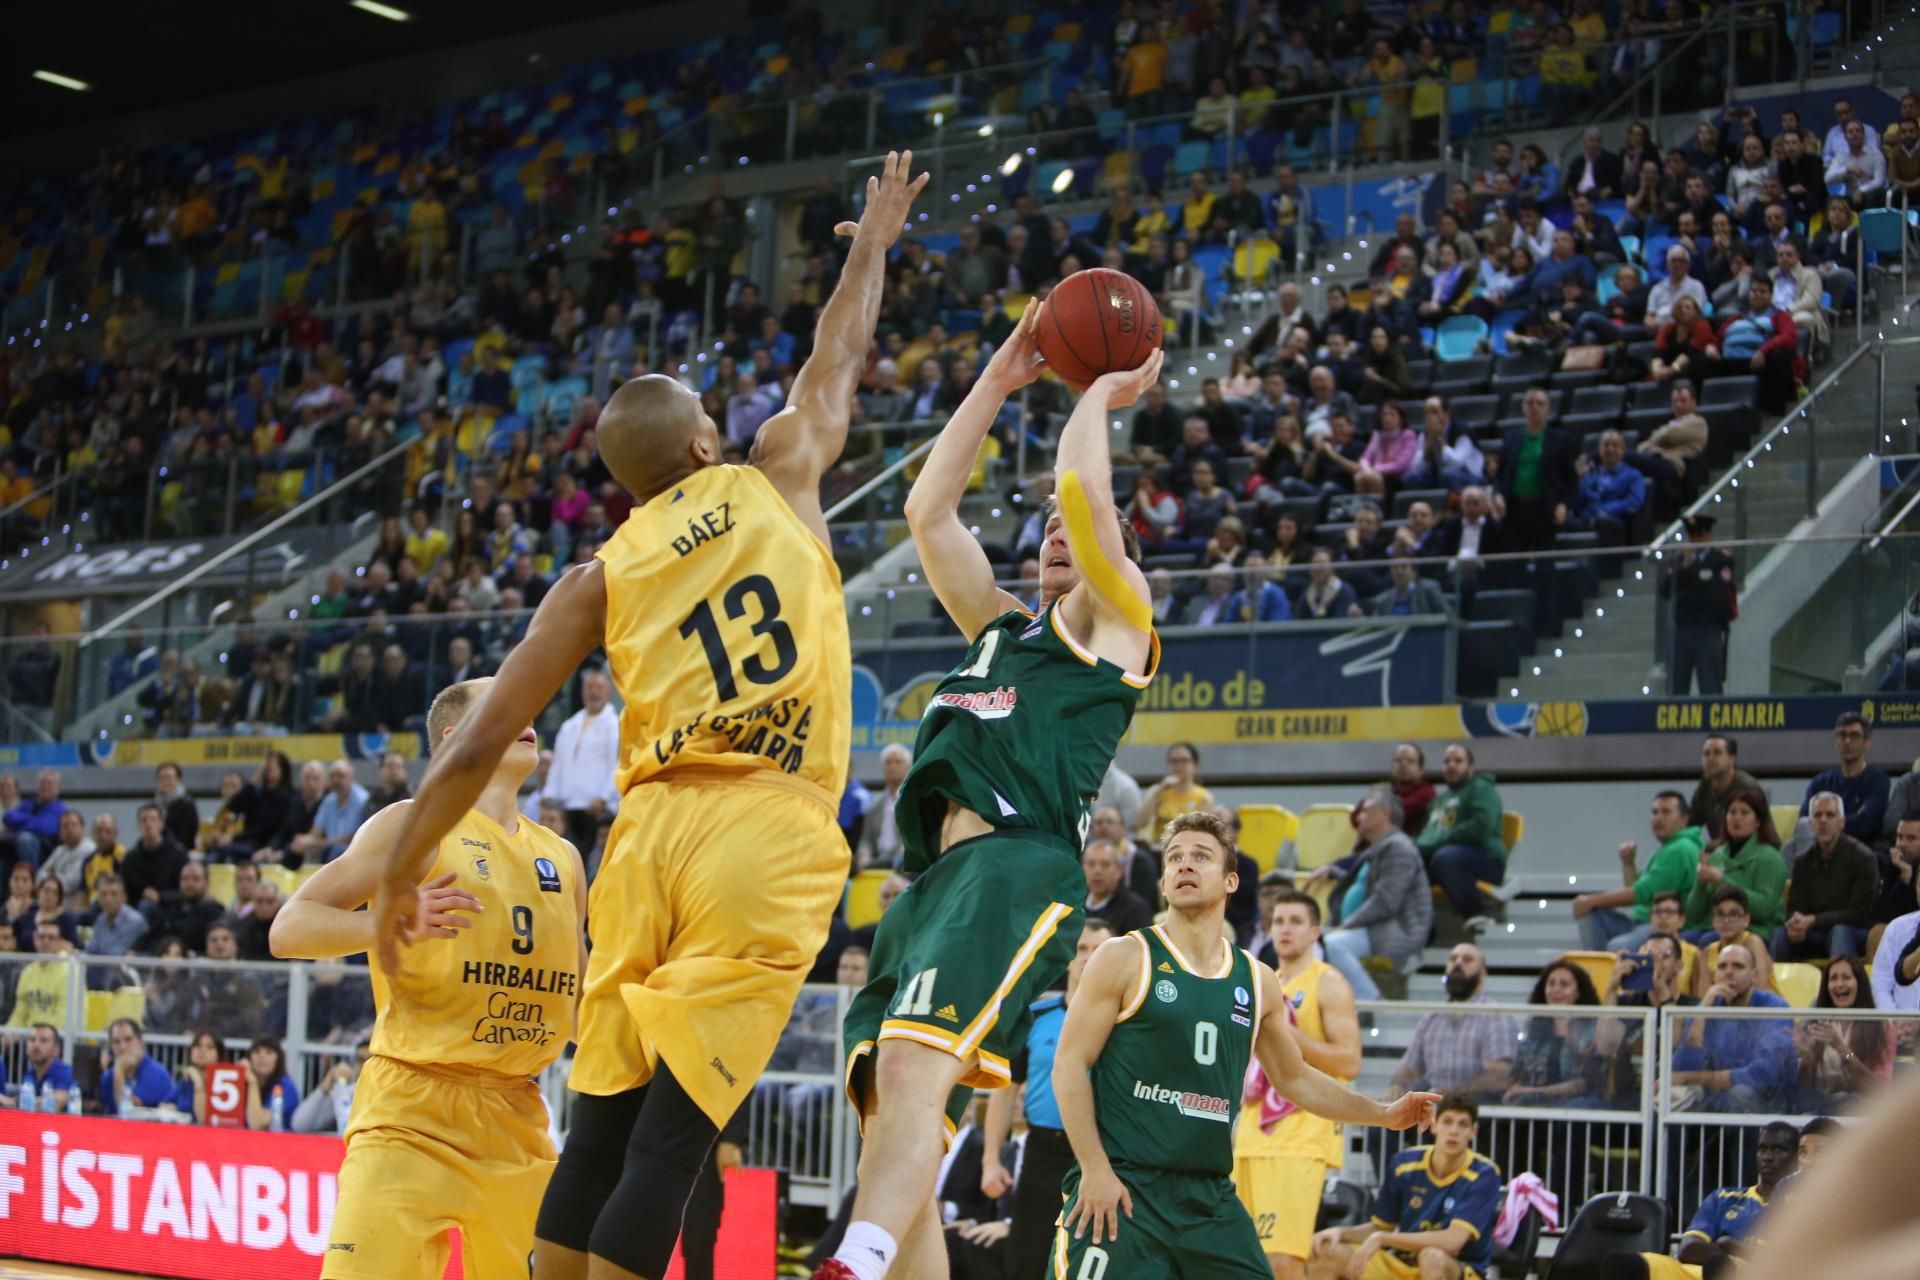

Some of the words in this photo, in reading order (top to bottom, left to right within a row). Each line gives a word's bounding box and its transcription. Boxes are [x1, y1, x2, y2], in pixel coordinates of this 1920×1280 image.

[670, 502, 736, 557] BÁEZ
[678, 574, 798, 702] 13
[958, 629, 1000, 679] 1
[1222, 670, 1265, 706] de
[1236, 715, 1275, 738] GRAN
[1281, 714, 1348, 737] CANARIA
[1656, 704, 1702, 730] GRAN
[1709, 702, 1786, 729] CANARIA
[512, 905, 533, 955] 9
[463, 961, 576, 996] HERBALIFE
[894, 967, 938, 1015] 11
[488, 992, 542, 1024] Gran
[1194, 1021, 1219, 1066] 0
[210, 1068, 240, 1113] 5
[1257, 1213, 1276, 1240] 22
